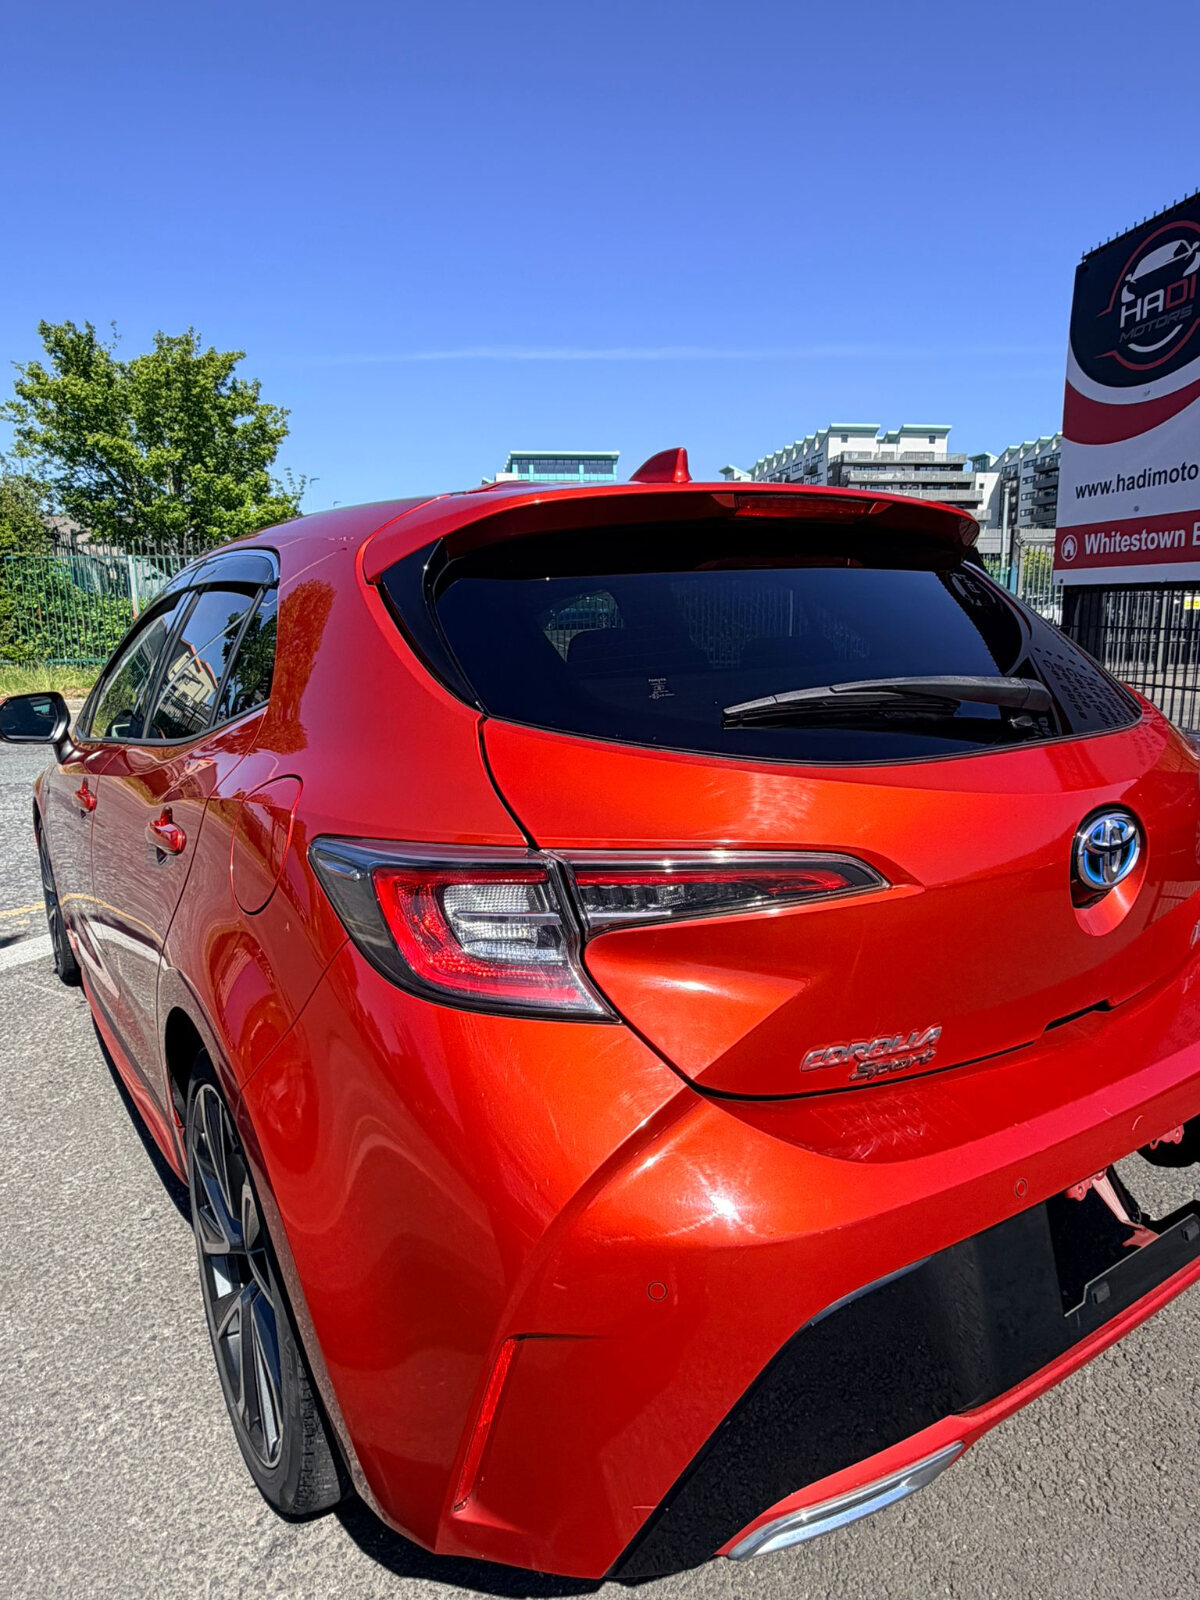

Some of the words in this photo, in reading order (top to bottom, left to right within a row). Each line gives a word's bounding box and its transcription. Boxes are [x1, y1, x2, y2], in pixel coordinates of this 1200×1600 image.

[1120, 273, 1197, 328] HADI
[1119, 304, 1193, 342] MOTORS
[1075, 462, 1199, 499] www.hadimoto
[1084, 528, 1186, 555] Whitestown
[801, 1025, 942, 1072] COROLLA
